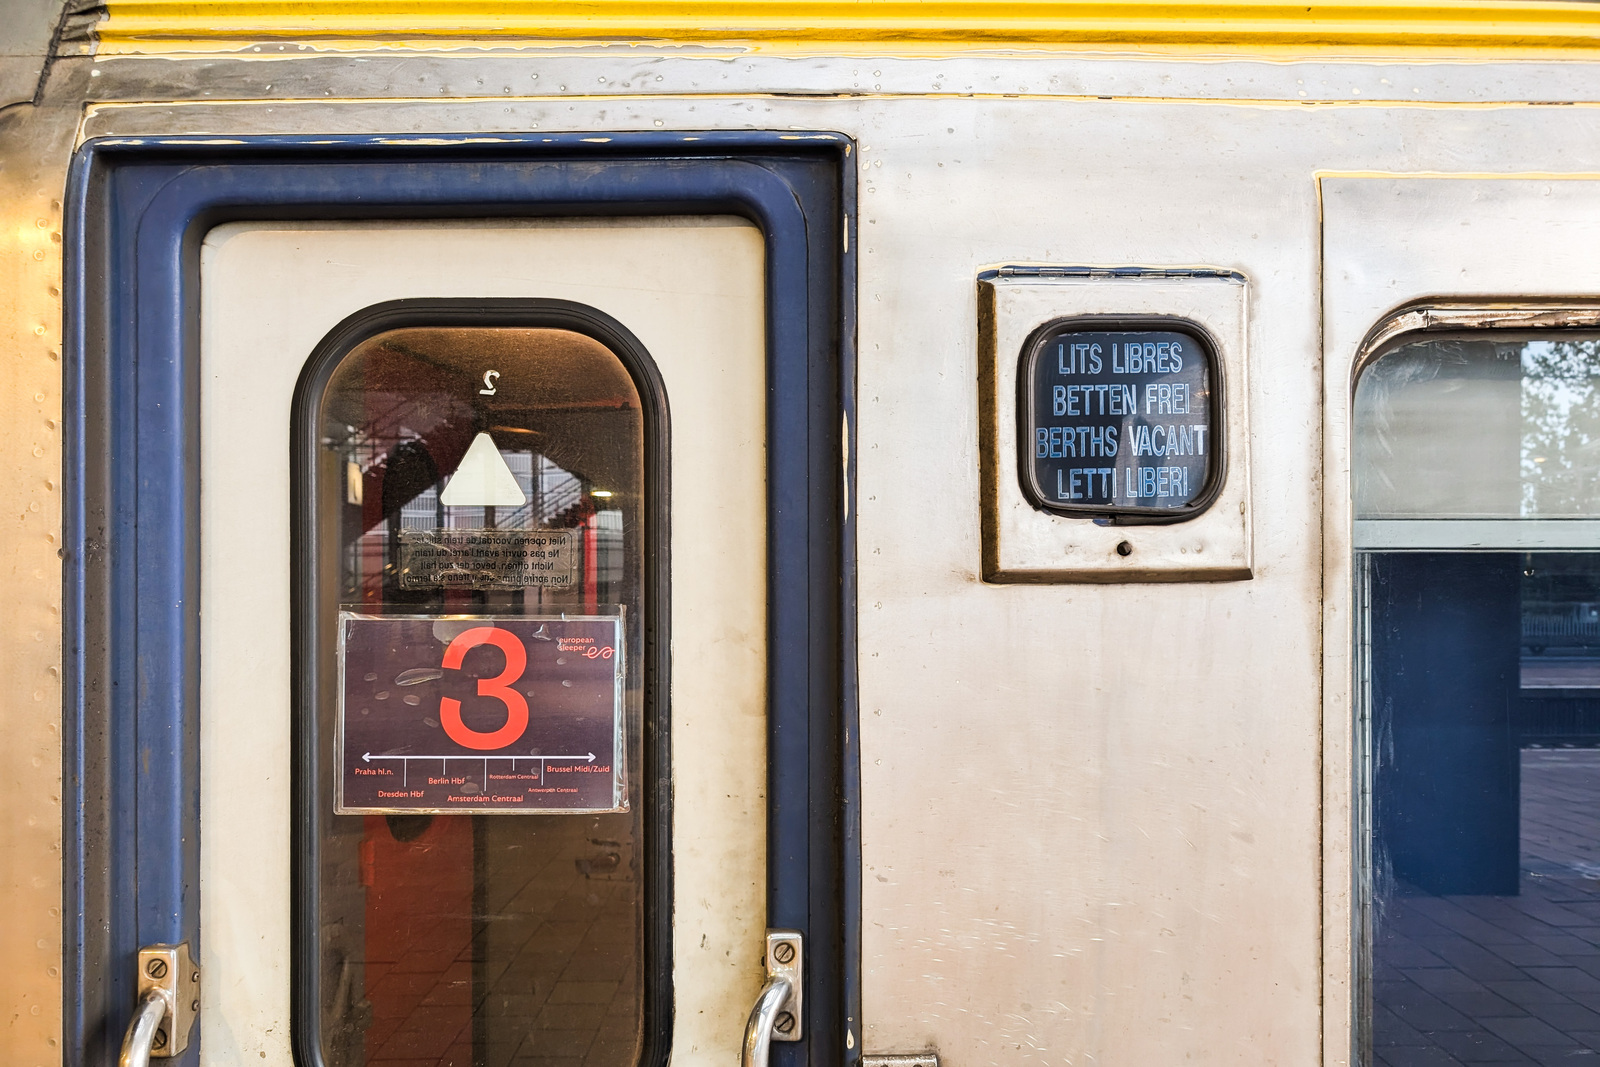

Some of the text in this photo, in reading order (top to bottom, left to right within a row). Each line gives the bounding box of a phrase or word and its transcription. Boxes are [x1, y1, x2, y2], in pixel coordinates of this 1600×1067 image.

[1058, 342, 1183, 374] LITS LIBRES
[1053, 383, 1190, 416] BETTEN FREI
[1035, 425, 1208, 458] BERTHS VACANT
[1057, 466, 1188, 499] LETTI LIBERI
[558, 636, 595, 644] european
[558, 643, 586, 652] sleeper
[439, 626, 530, 751] 3
[354, 767, 394, 776] Praha hl.n.
[546, 765, 610, 774] Brussel Midi/Zuid
[428, 777, 466, 785] Berlin Hbf
[378, 790, 425, 798] Dresden Hbf
[447, 795, 524, 803] Amsterdam Centraal
